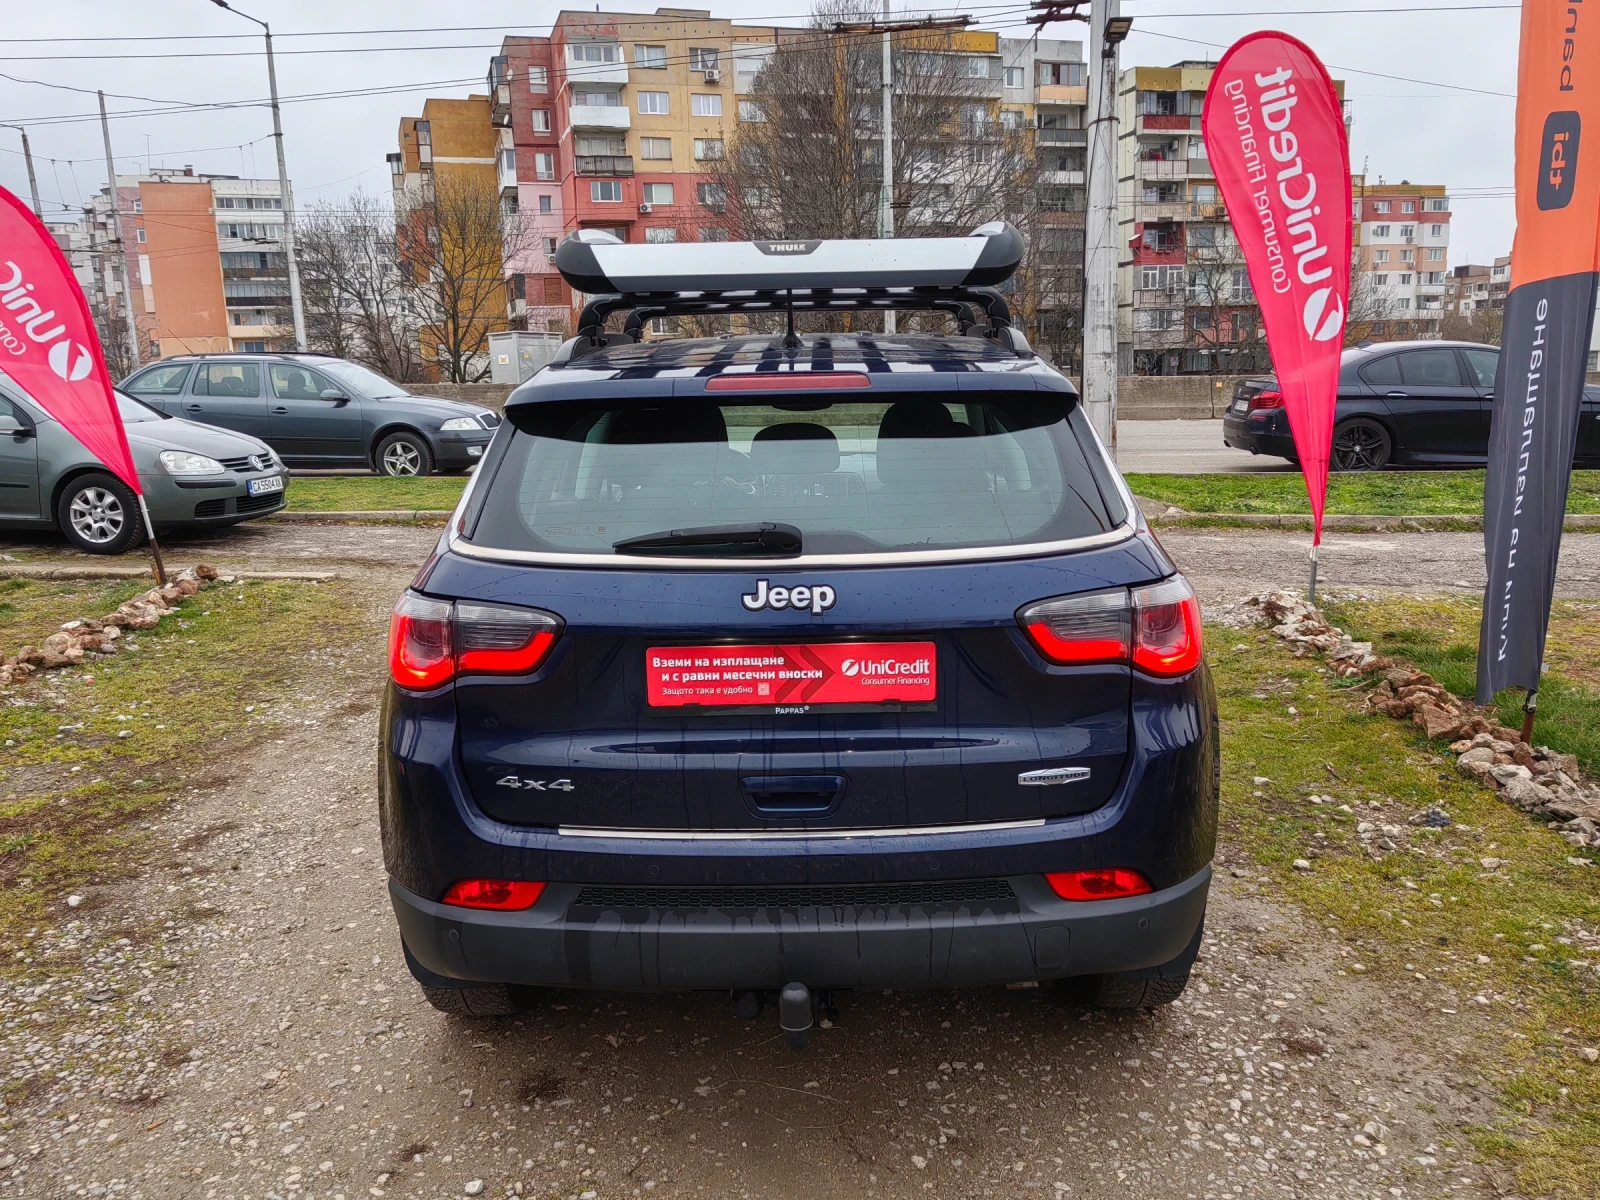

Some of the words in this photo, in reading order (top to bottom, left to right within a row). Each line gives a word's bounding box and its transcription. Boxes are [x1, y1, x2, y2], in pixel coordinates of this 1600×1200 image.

[768, 243, 806, 252] THULE
[742, 580, 836, 614] Jeep
[652, 657, 692, 668] Вземи
[695, 657, 710, 667] на
[713, 656, 785, 667] изплащане
[861, 658, 930, 675] UniCredit
[661, 673, 670, 682] и
[672, 673, 680, 681] с
[682, 672, 720, 684] равни
[723, 671, 776, 680] месечни
[778, 669, 823, 679] вноски
[861, 677, 896, 686] Consumer
[897, 676, 930, 686] Financing
[661, 687, 694, 696] Защото
[696, 687, 715, 695] така
[723, 685, 753, 696] удобно
[1022, 771, 1090, 783] LONGITUDE
[496, 775, 575, 792] 4x4
